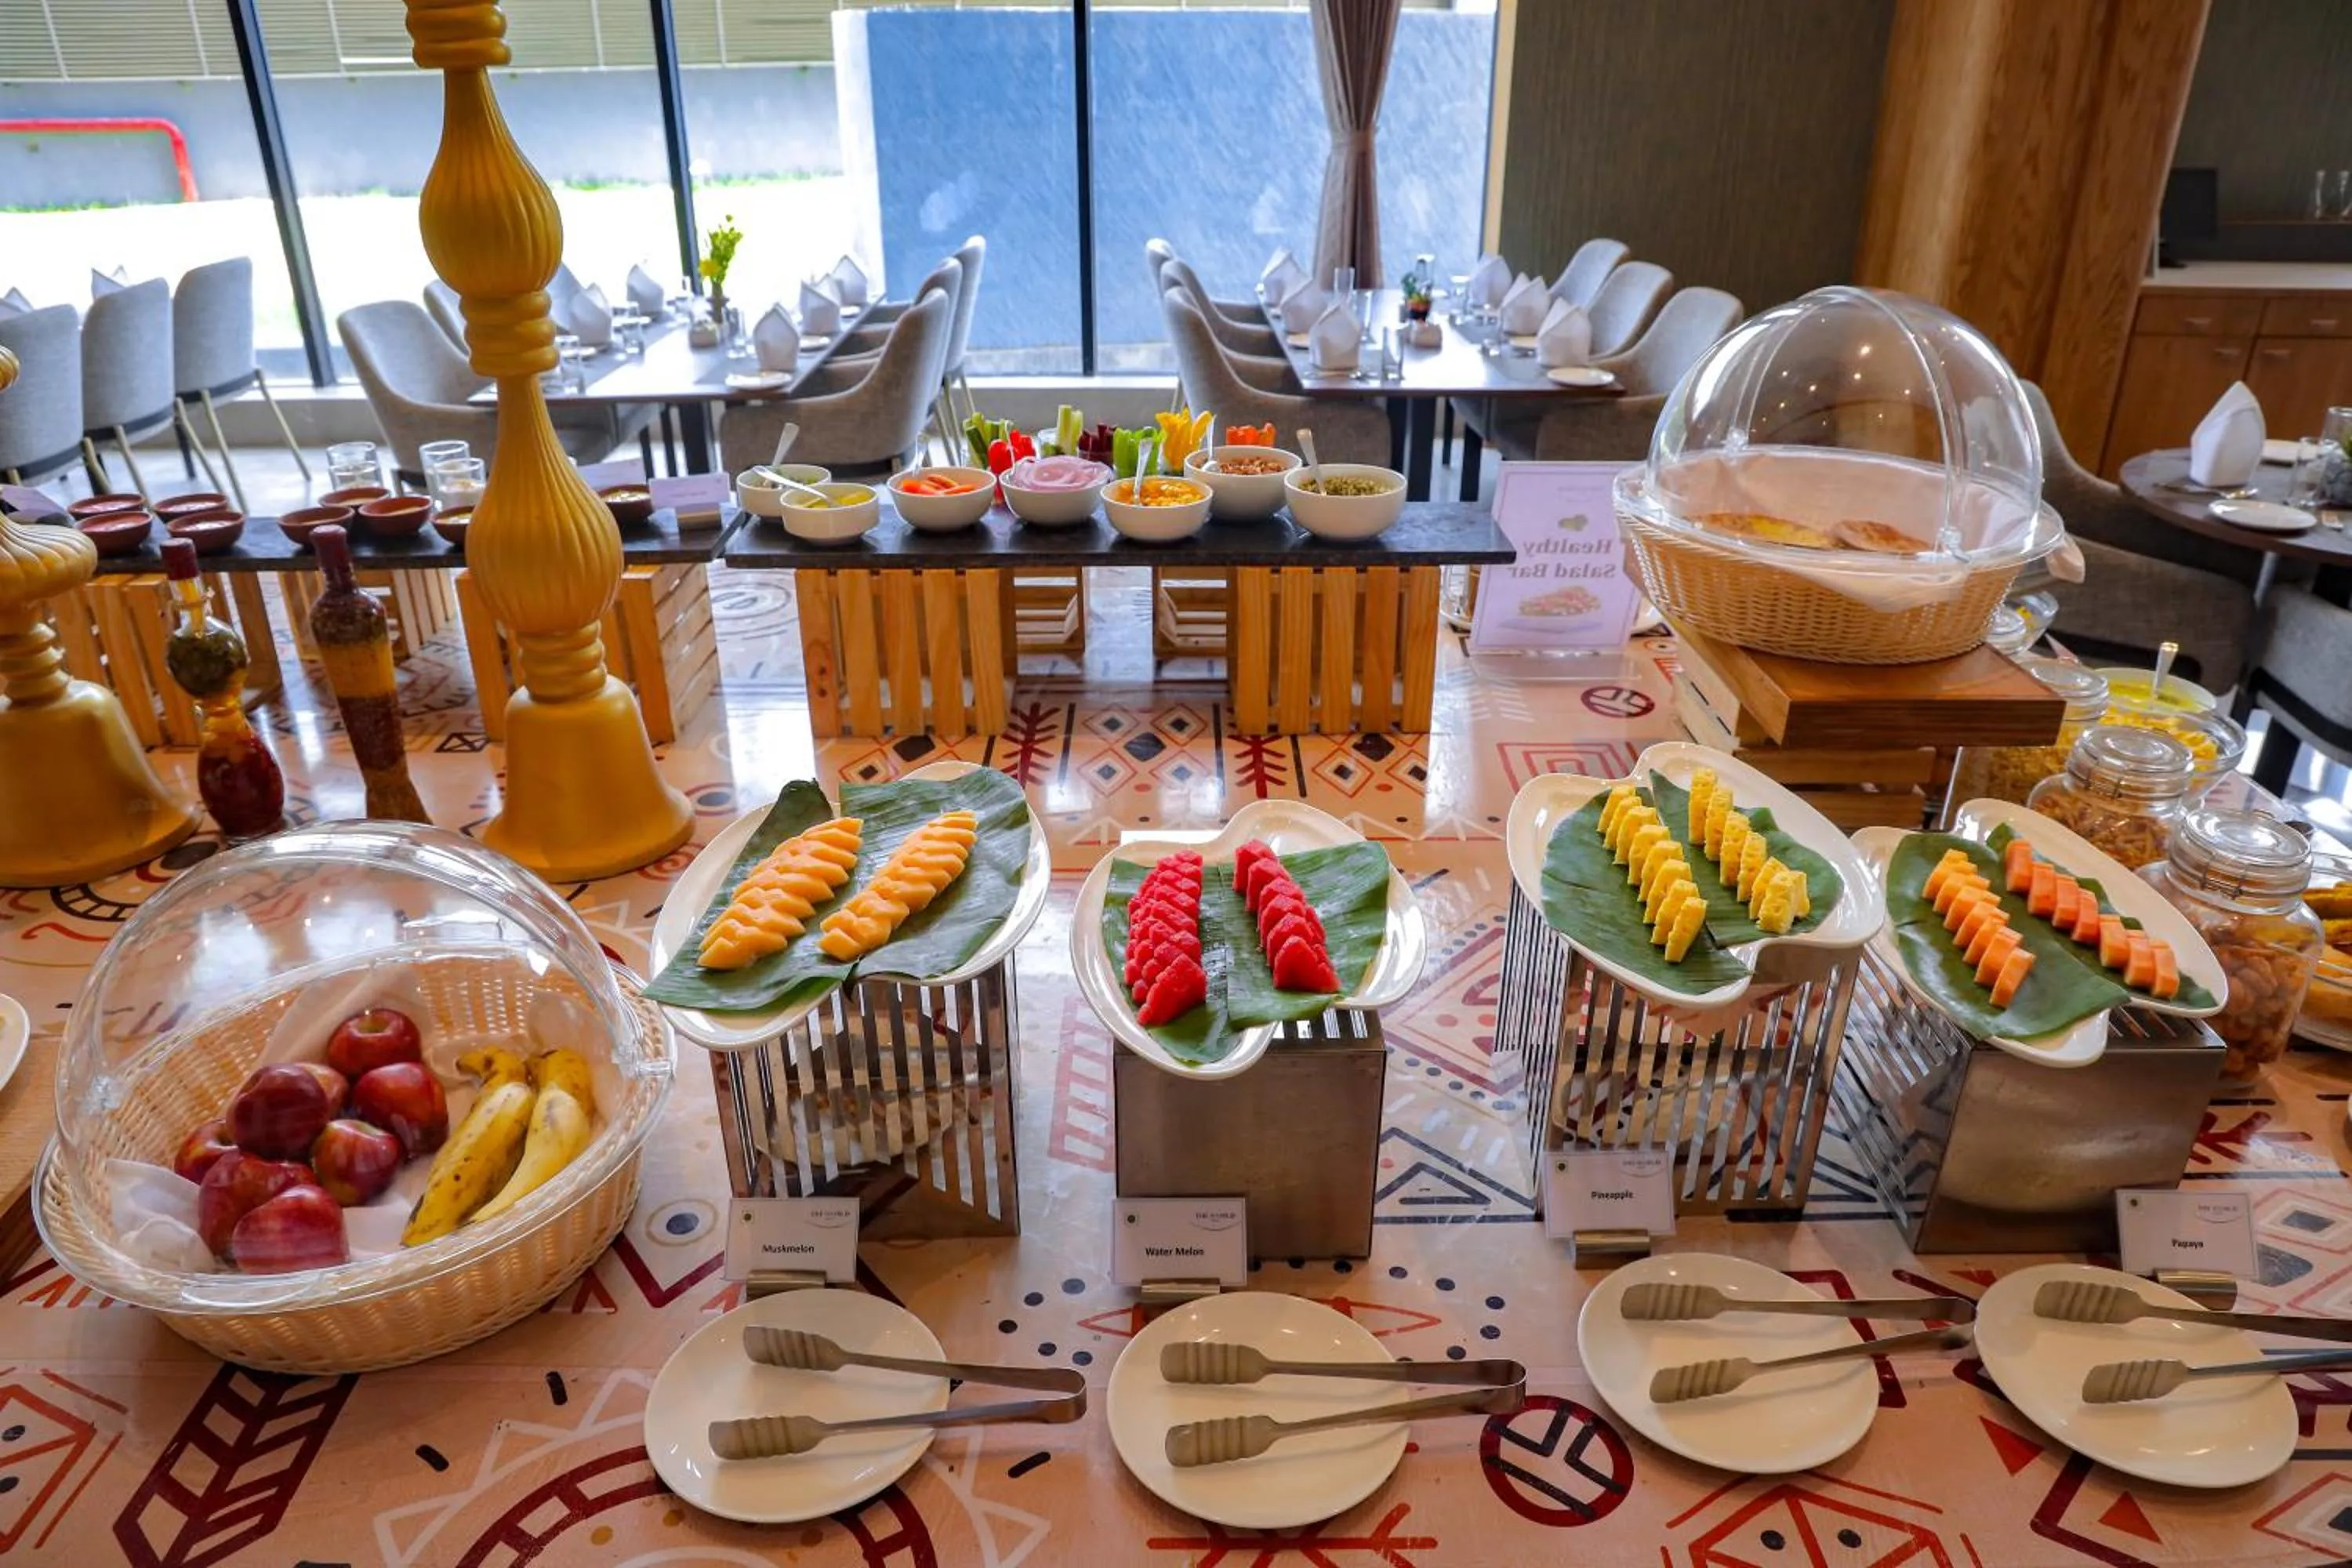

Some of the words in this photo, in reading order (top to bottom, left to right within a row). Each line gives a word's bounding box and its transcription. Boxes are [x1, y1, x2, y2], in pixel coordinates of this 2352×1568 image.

[1591, 1189, 1634, 1200] Pineapple
[762, 1244, 815, 1254] Muskmelon
[2172, 1239, 2204, 1249] Papaya
[1145, 1247, 1172, 1256] Water
[1175, 1247, 1204, 1256] Melon
